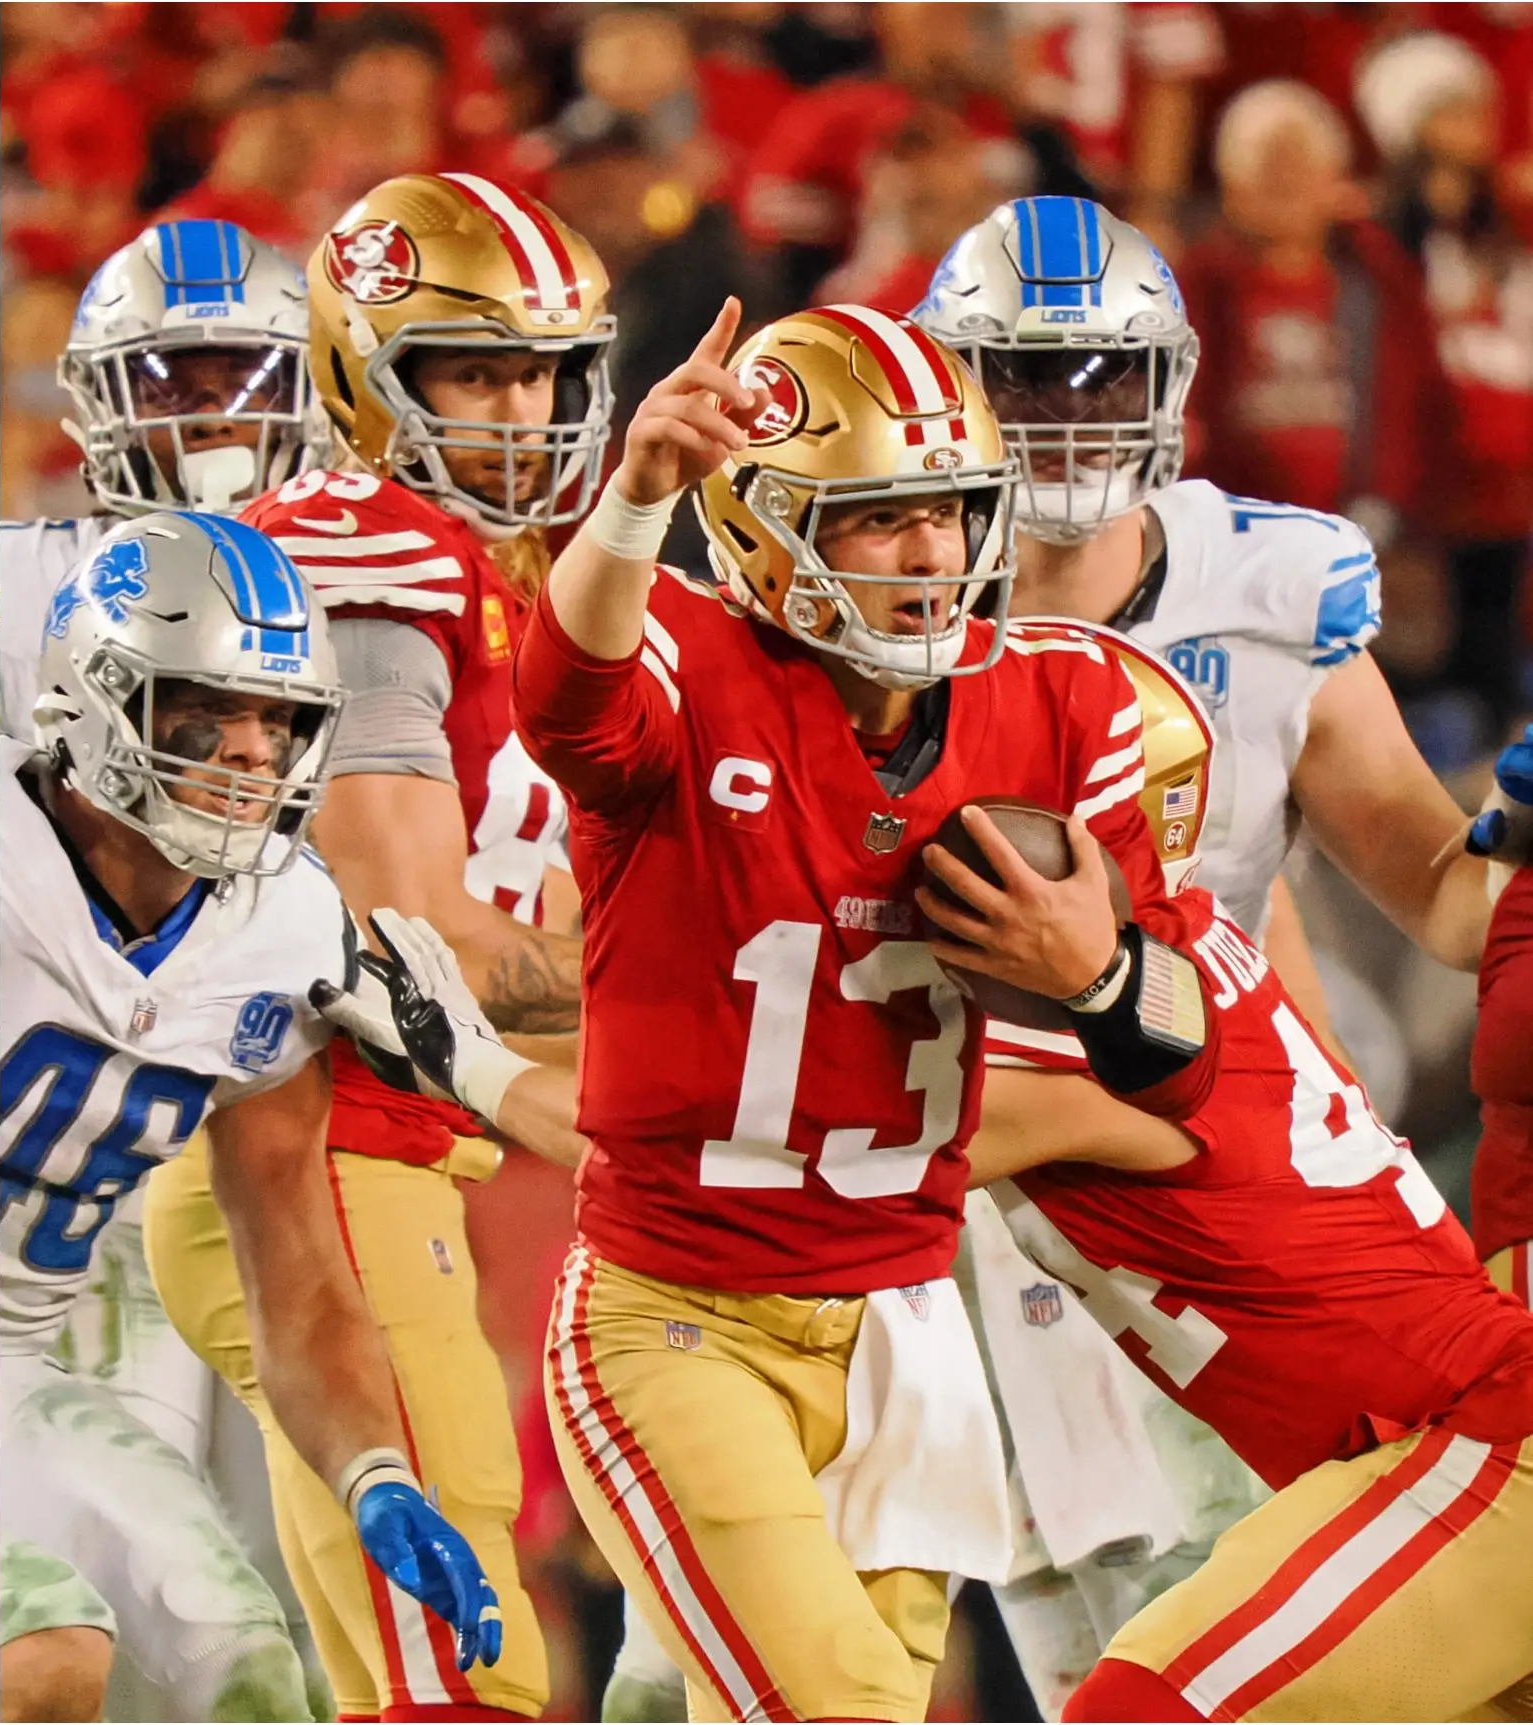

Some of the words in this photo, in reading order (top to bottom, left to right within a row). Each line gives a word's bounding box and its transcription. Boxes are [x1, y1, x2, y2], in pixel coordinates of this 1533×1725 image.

[708, 756, 772, 814] C
[1166, 825, 1185, 849] 64
[700, 920, 965, 1199] 13
